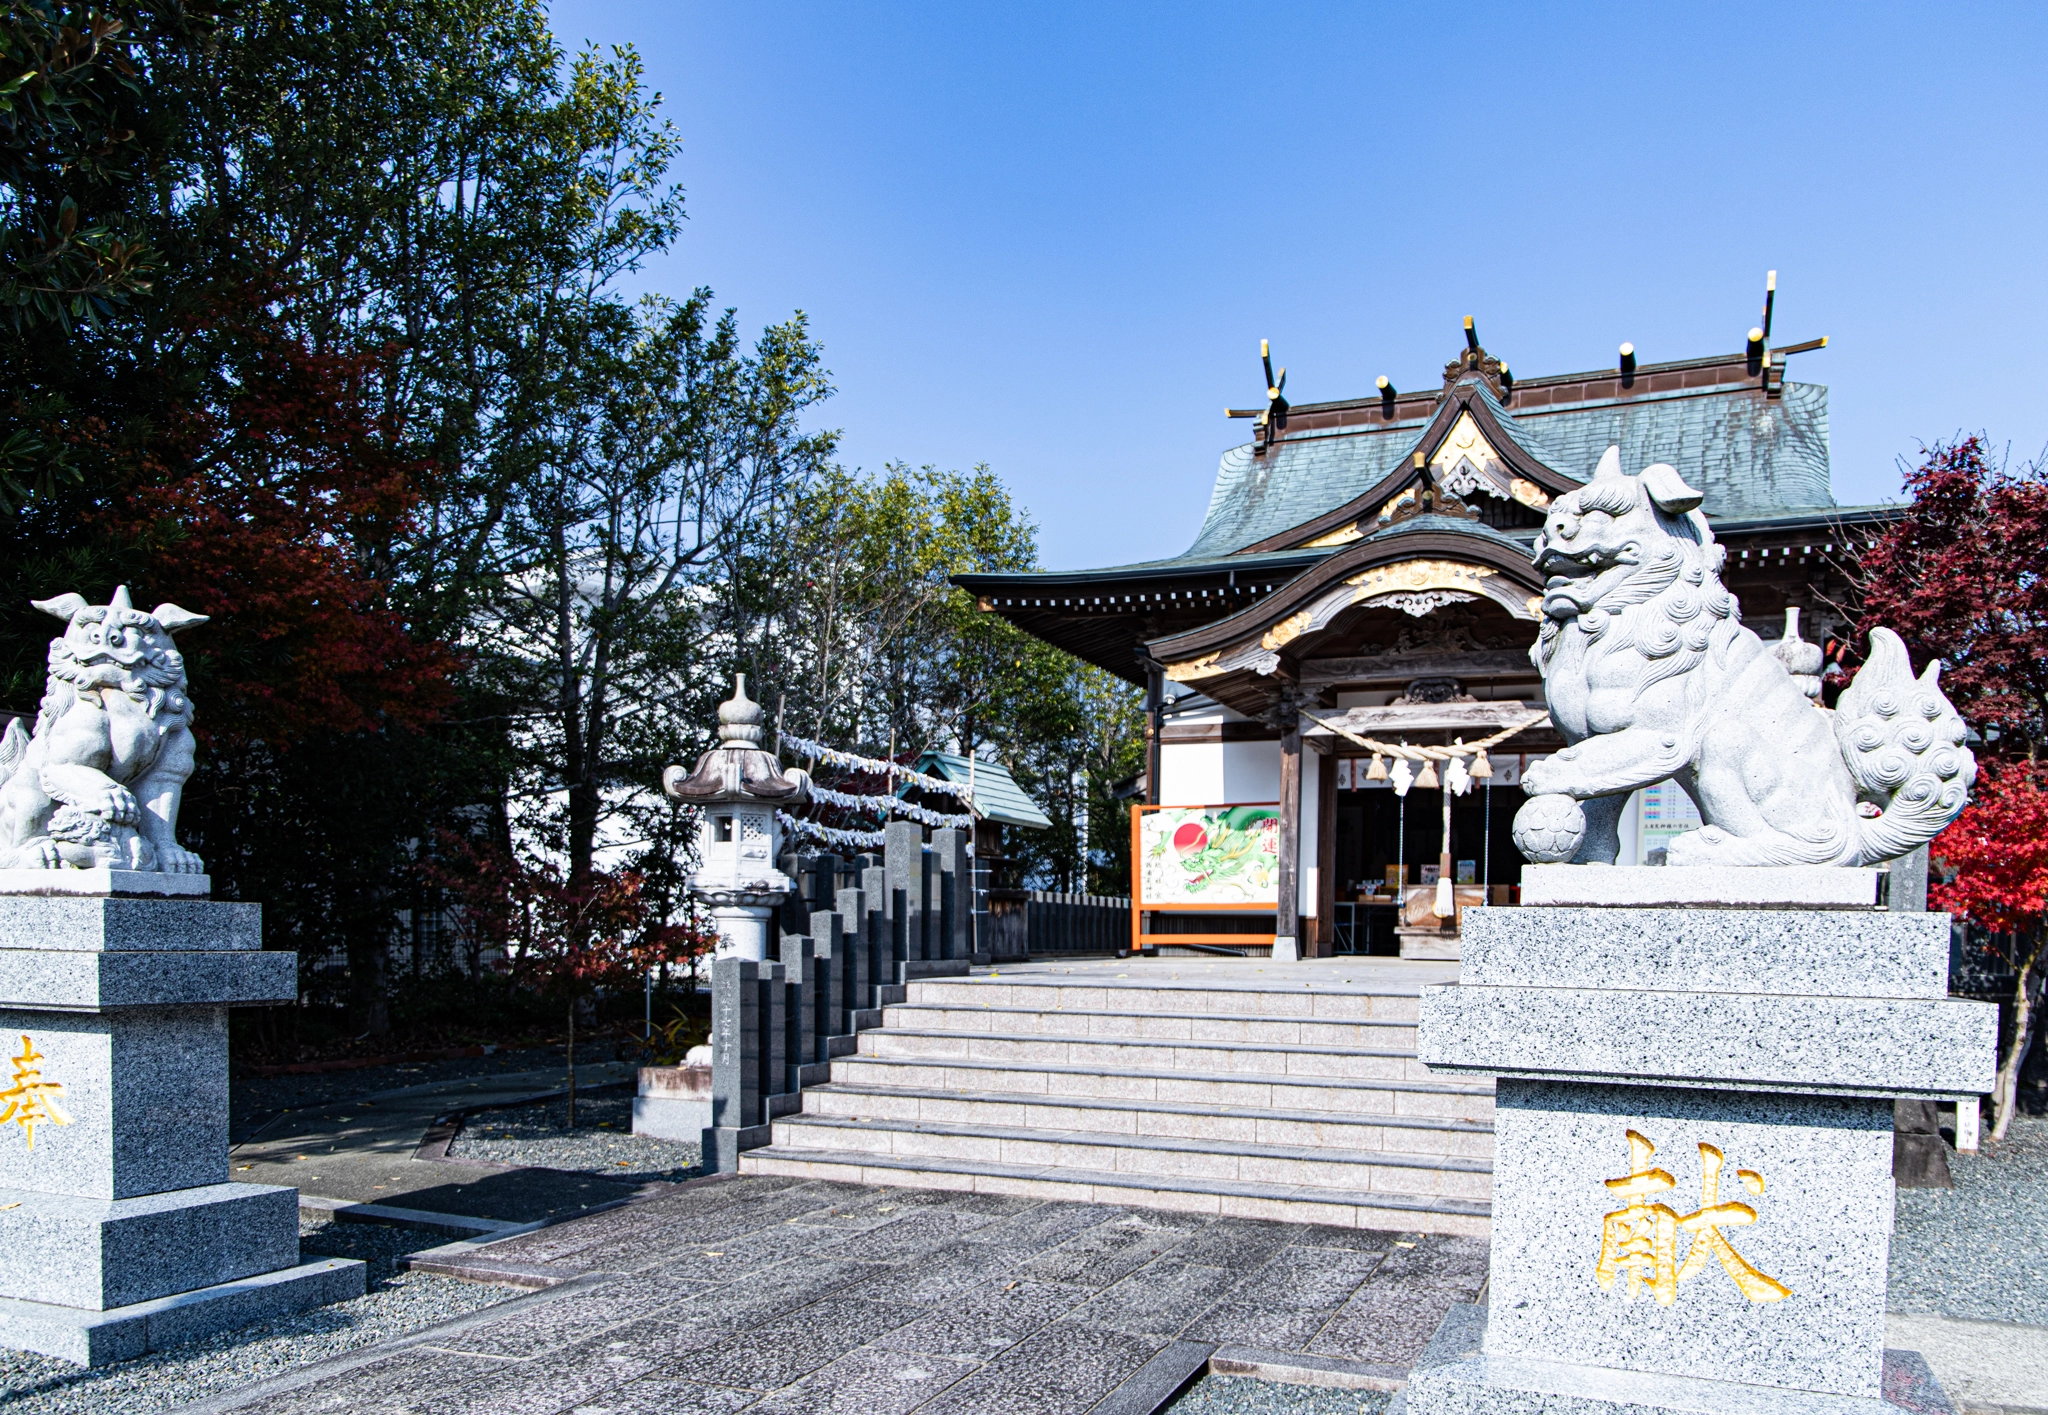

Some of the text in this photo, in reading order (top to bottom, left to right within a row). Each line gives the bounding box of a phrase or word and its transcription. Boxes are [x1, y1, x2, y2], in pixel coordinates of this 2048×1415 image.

[1262, 817, 1278, 853] 開運
[0, 1035, 75, 1150] 奉
[1596, 1129, 1793, 1307] 献
